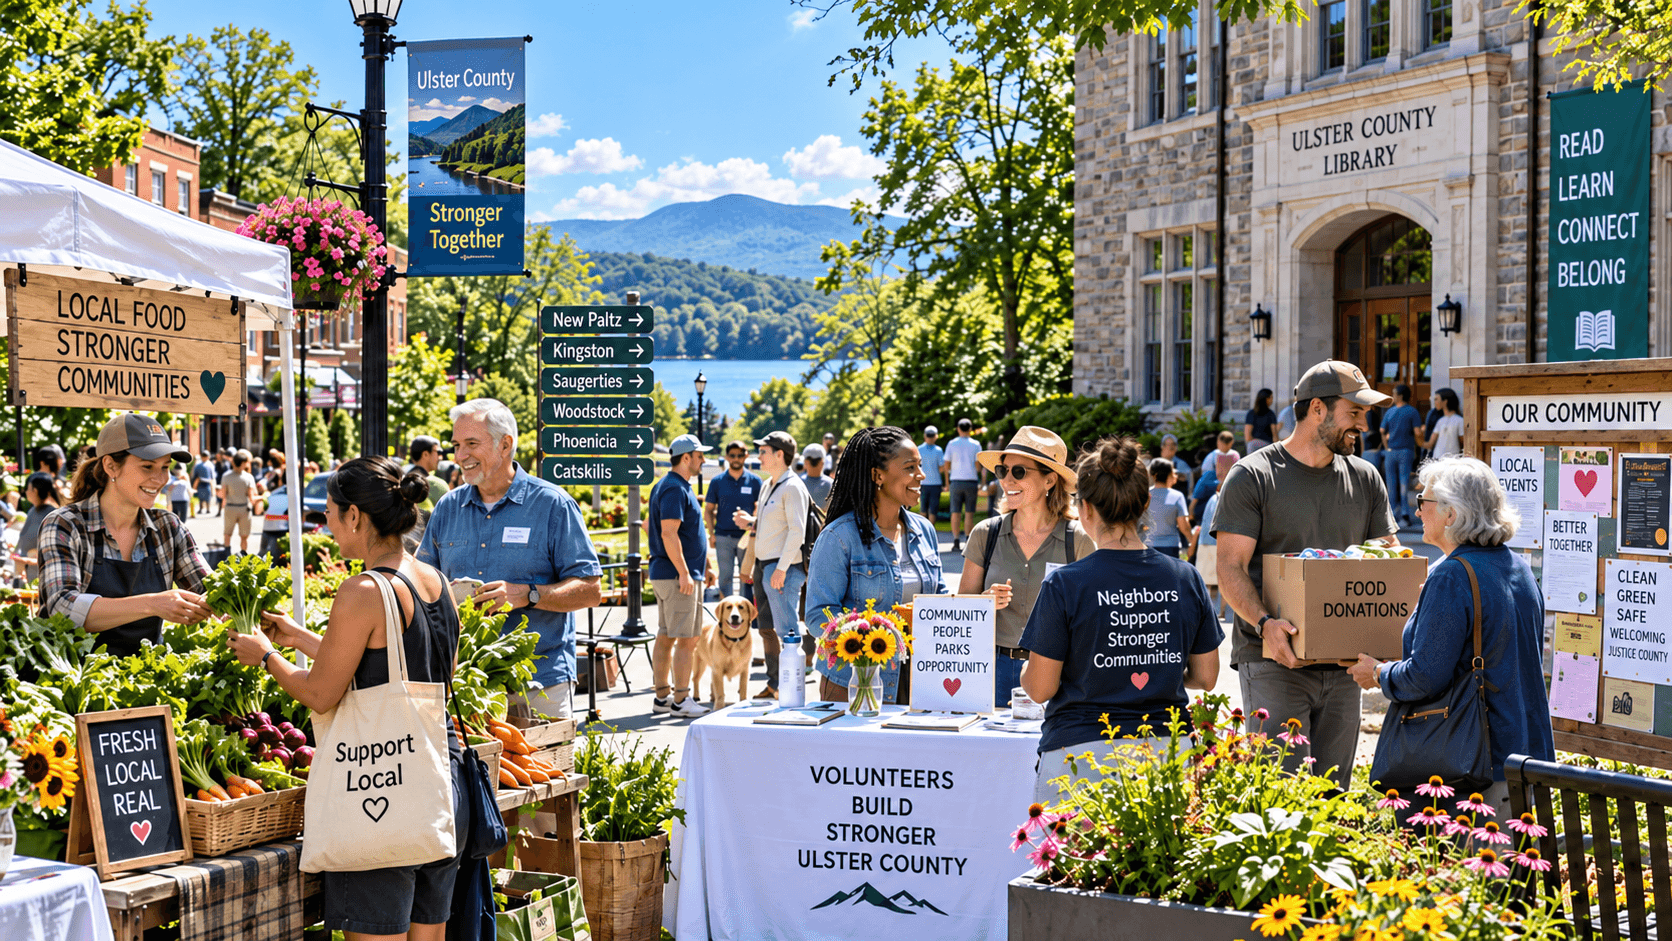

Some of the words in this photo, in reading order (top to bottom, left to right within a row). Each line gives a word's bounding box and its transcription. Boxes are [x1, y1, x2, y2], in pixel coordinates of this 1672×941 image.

[418, 70, 460, 89] Ulster
[464, 69, 514, 90] County
[1292, 122, 1354, 152] ULSTER
[1362, 106, 1436, 138] COUNTY
[1560, 129, 1603, 158] READ
[1324, 143, 1398, 176] LIBRARY
[1559, 171, 1613, 201] LEARN
[430, 203, 502, 227] Stronger
[1558, 212, 1639, 244] CONNECT
[430, 228, 504, 254] Together
[1558, 258, 1625, 287] BELONG
[58, 290, 125, 323] LOCAL
[134, 301, 185, 332] FOOD
[554, 312, 583, 327] New
[589, 312, 621, 327] Paltz
[57, 329, 170, 365] STRONGER
[554, 343, 613, 362] Kingston
[58, 366, 190, 399] COMMUNITIES
[553, 373, 622, 392] Saugerties
[553, 403, 625, 418] Woodstock
[1502, 404, 1538, 423] OUR
[1546, 401, 1661, 422] COMMUNITY
[554, 433, 616, 448] Phoenicia
[554, 463, 612, 479] Catskilis
[1500, 459, 1535, 472] LOCAL
[1553, 520, 1586, 534] BETTER
[1550, 539, 1592, 552] TOGETHER
[1618, 570, 1656, 585] CLEAN
[1097, 588, 1178, 608] Neighbors
[1346, 581, 1386, 596] FOOD
[1617, 589, 1655, 604] GREEN
[919, 609, 987, 621] COMMUNITY
[1110, 610, 1170, 629] Support
[1324, 603, 1408, 617] DONATIONS
[1617, 608, 1646, 623] SAFE
[934, 626, 971, 637] PEOPLE
[1108, 632, 1170, 648] Stronger
[1610, 627, 1665, 644] WELCOMING
[936, 643, 970, 655] PARKS
[1094, 649, 1181, 668] Communities
[1608, 646, 1636, 659] JUSTICE
[1638, 649, 1668, 662] COUNTY
[917, 661, 988, 673] OPPORTUNITY
[99, 729, 156, 755] FRESH
[336, 734, 414, 766] Support
[105, 760, 161, 786] LOCAL
[347, 763, 402, 791] Local
[810, 766, 953, 789] VOLUNTEERS
[114, 789, 161, 816] REAL
[853, 796, 912, 816] BUILD
[827, 823, 935, 845] STRONGER
[799, 850, 872, 871] ULSTER
[880, 854, 967, 875] COUNTY
